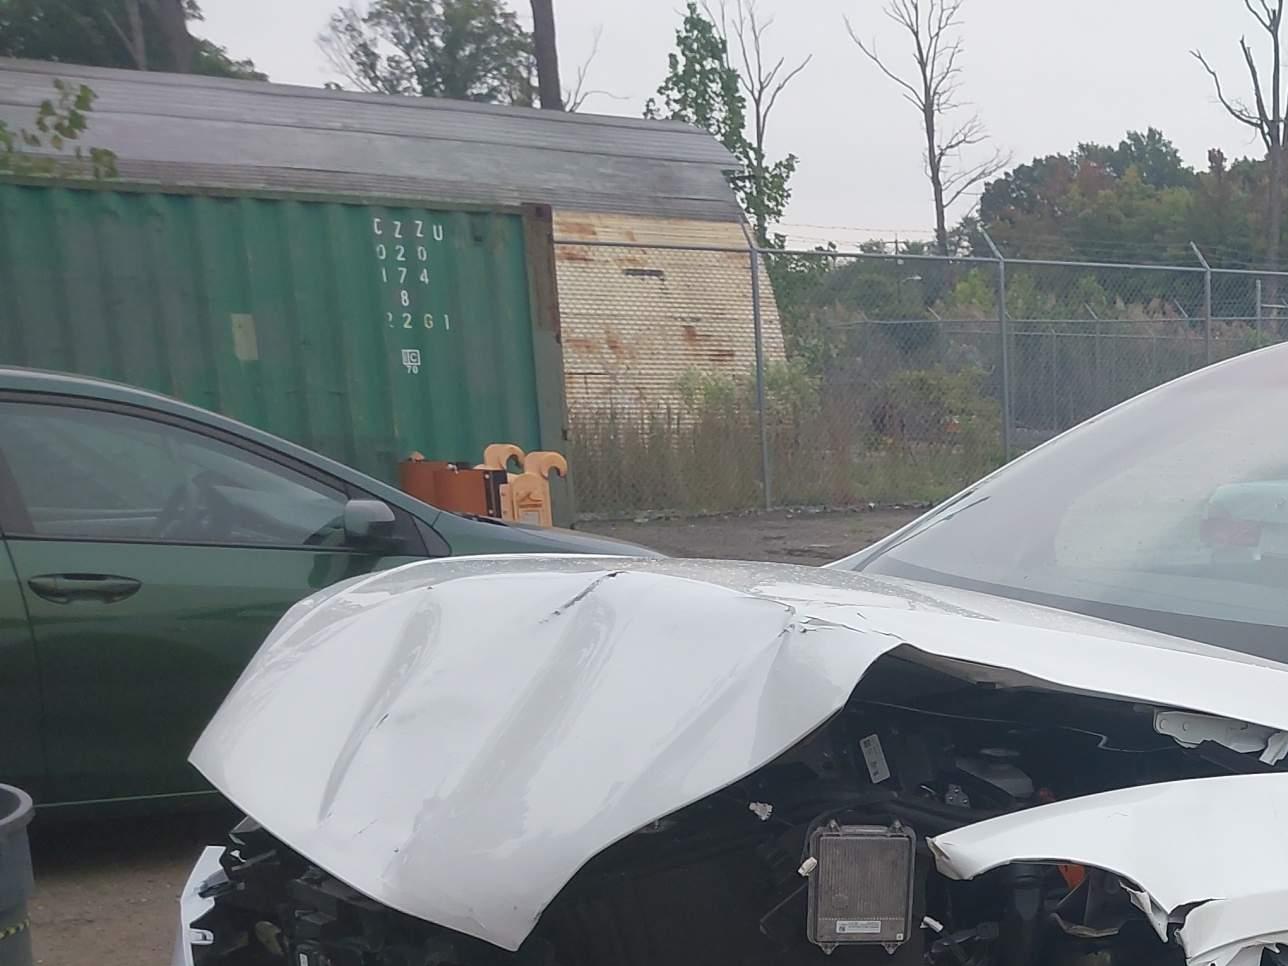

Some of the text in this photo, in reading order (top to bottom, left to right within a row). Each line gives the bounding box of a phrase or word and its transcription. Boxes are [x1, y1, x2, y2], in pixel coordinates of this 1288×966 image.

[373, 218, 444, 241] CZZU
[376, 244, 428, 261] 020
[381, 267, 430, 285] 174
[400, 290, 410, 306] 8
